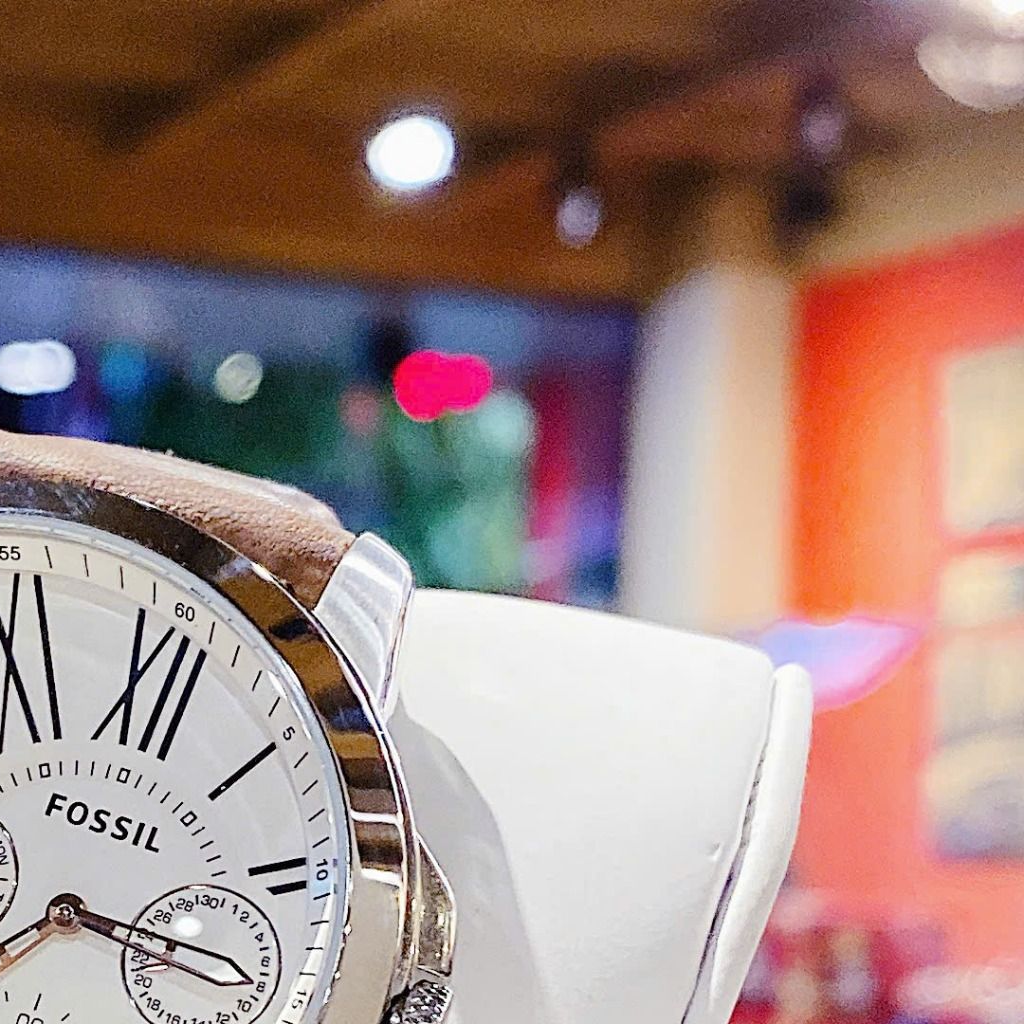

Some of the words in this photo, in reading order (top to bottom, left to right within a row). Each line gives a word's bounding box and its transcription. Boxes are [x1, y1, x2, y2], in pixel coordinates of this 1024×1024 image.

[175, 602, 196, 622] 60
[90, 608, 207, 761] XII
[283, 726, 295, 741] 5
[45, 792, 161, 854] FOSSIL
[314, 858, 329, 882] 10
[175, 897, 195, 913] 28
[200, 894, 220, 910] 30
[153, 909, 173, 925] 26
[239, 911, 250, 923] 2
[254, 932, 265, 943] 4
[130, 949, 150, 965] 22
[260, 956, 271, 968] 6
[133, 973, 153, 989] 20
[256, 981, 267, 993] 8
[146, 997, 161, 1011] 18
[236, 998, 253, 1013] 10
[290, 990, 308, 1010] 15
